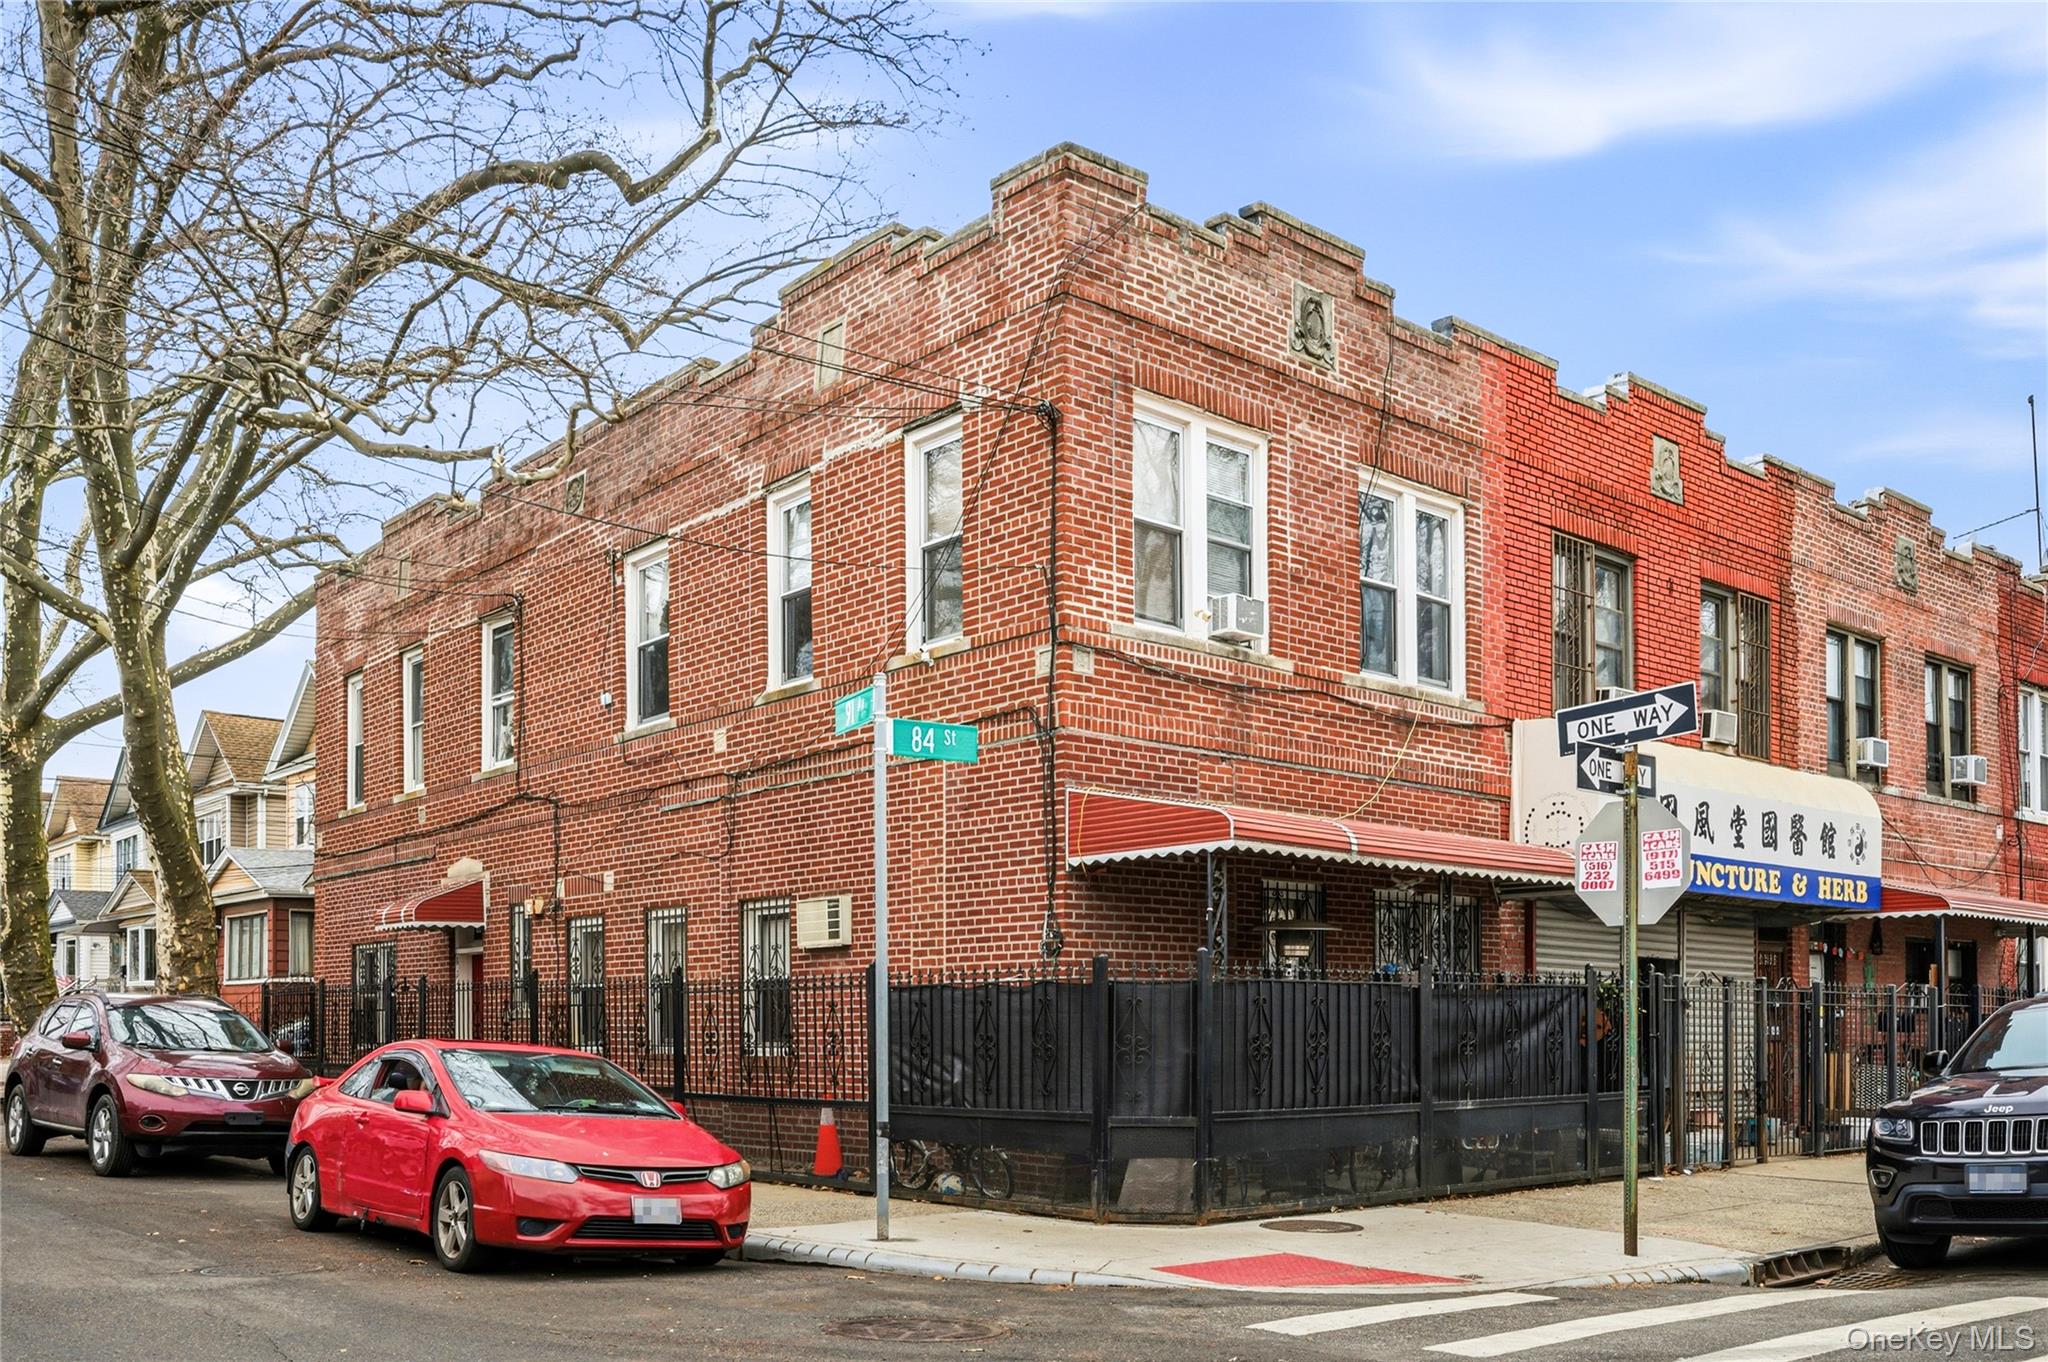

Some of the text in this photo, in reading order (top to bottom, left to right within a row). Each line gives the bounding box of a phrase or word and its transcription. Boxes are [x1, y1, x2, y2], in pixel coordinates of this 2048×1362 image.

[1577, 703, 1673, 739] ONE WAY
[911, 726, 956, 753] 84 St
[1589, 758, 1612, 780] ONE
[1642, 829, 1681, 842] CASH
[1581, 843, 1616, 853] CASH
[1645, 850, 1678, 860] (917)
[1584, 861, 1612, 870] (516)
[1650, 860, 1675, 870] 515
[1585, 871, 1610, 880] 232
[1644, 869, 1680, 881] 6499
[1581, 880, 1615, 890] 0007
[1792, 873, 1807, 897] &
[1818, 876, 1868, 903] HERB
[1984, 1103, 2014, 1114] Jeep
